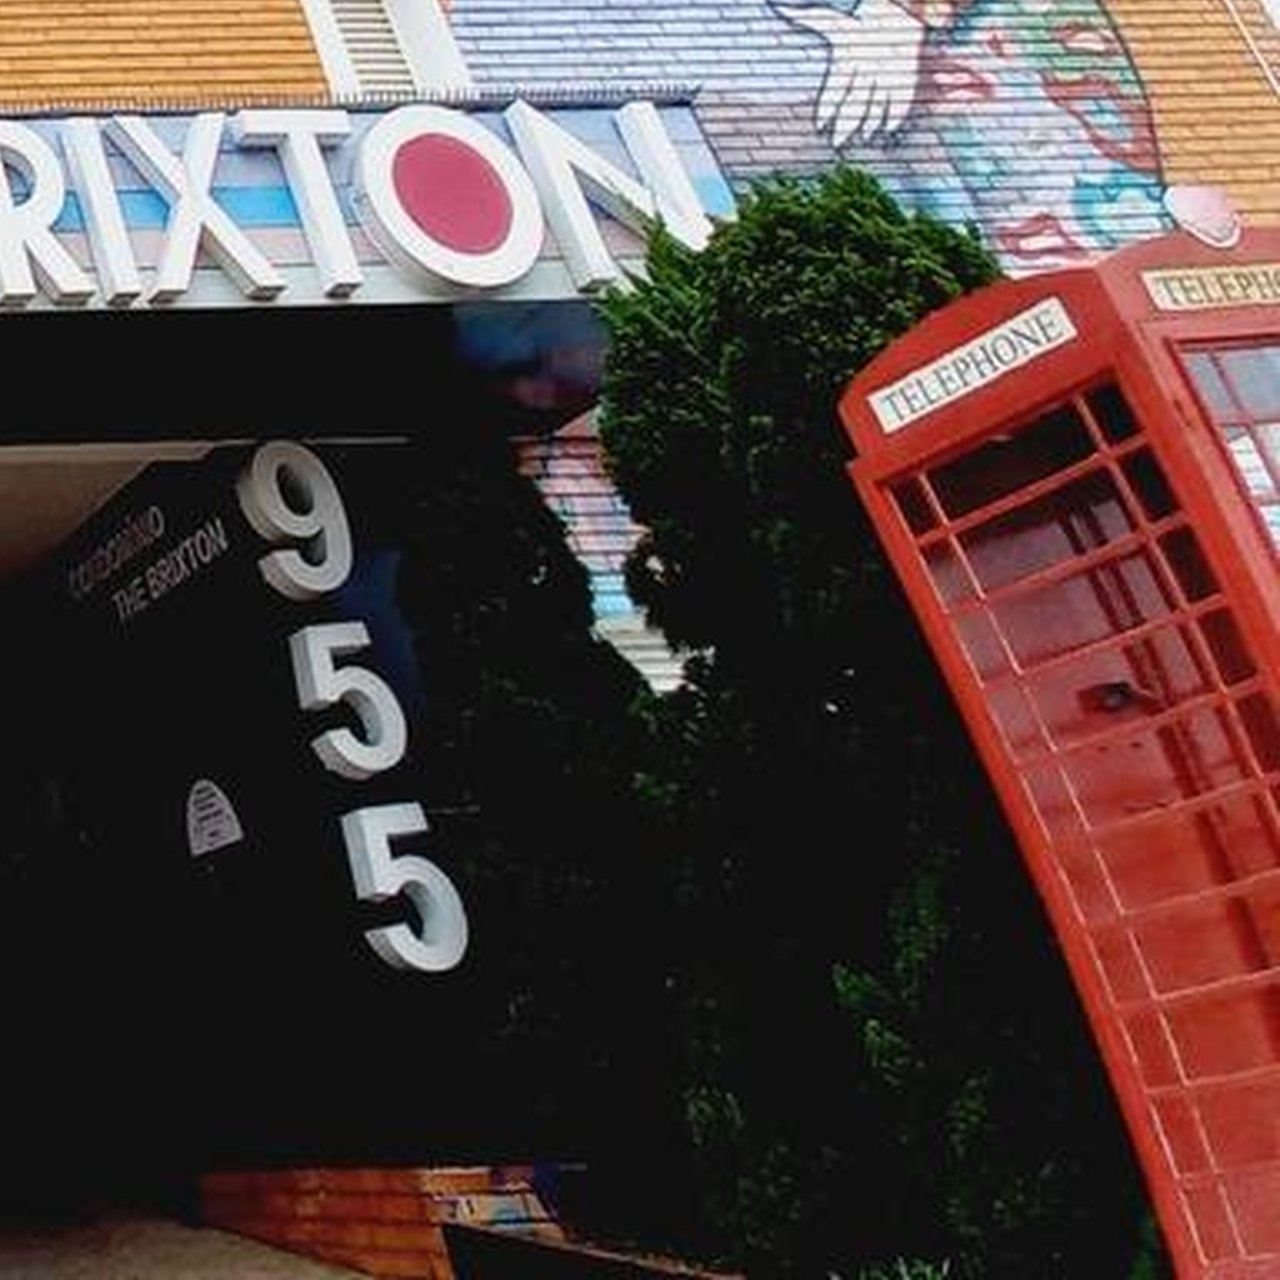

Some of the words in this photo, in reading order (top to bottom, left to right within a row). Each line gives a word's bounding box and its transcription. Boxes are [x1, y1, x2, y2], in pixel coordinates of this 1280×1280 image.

[880, 306, 1067, 423] TELEPHONE
[111, 576, 150, 620] THE
[144, 516, 230, 601] BRIXTON
[238, 438, 470, 973] 955
